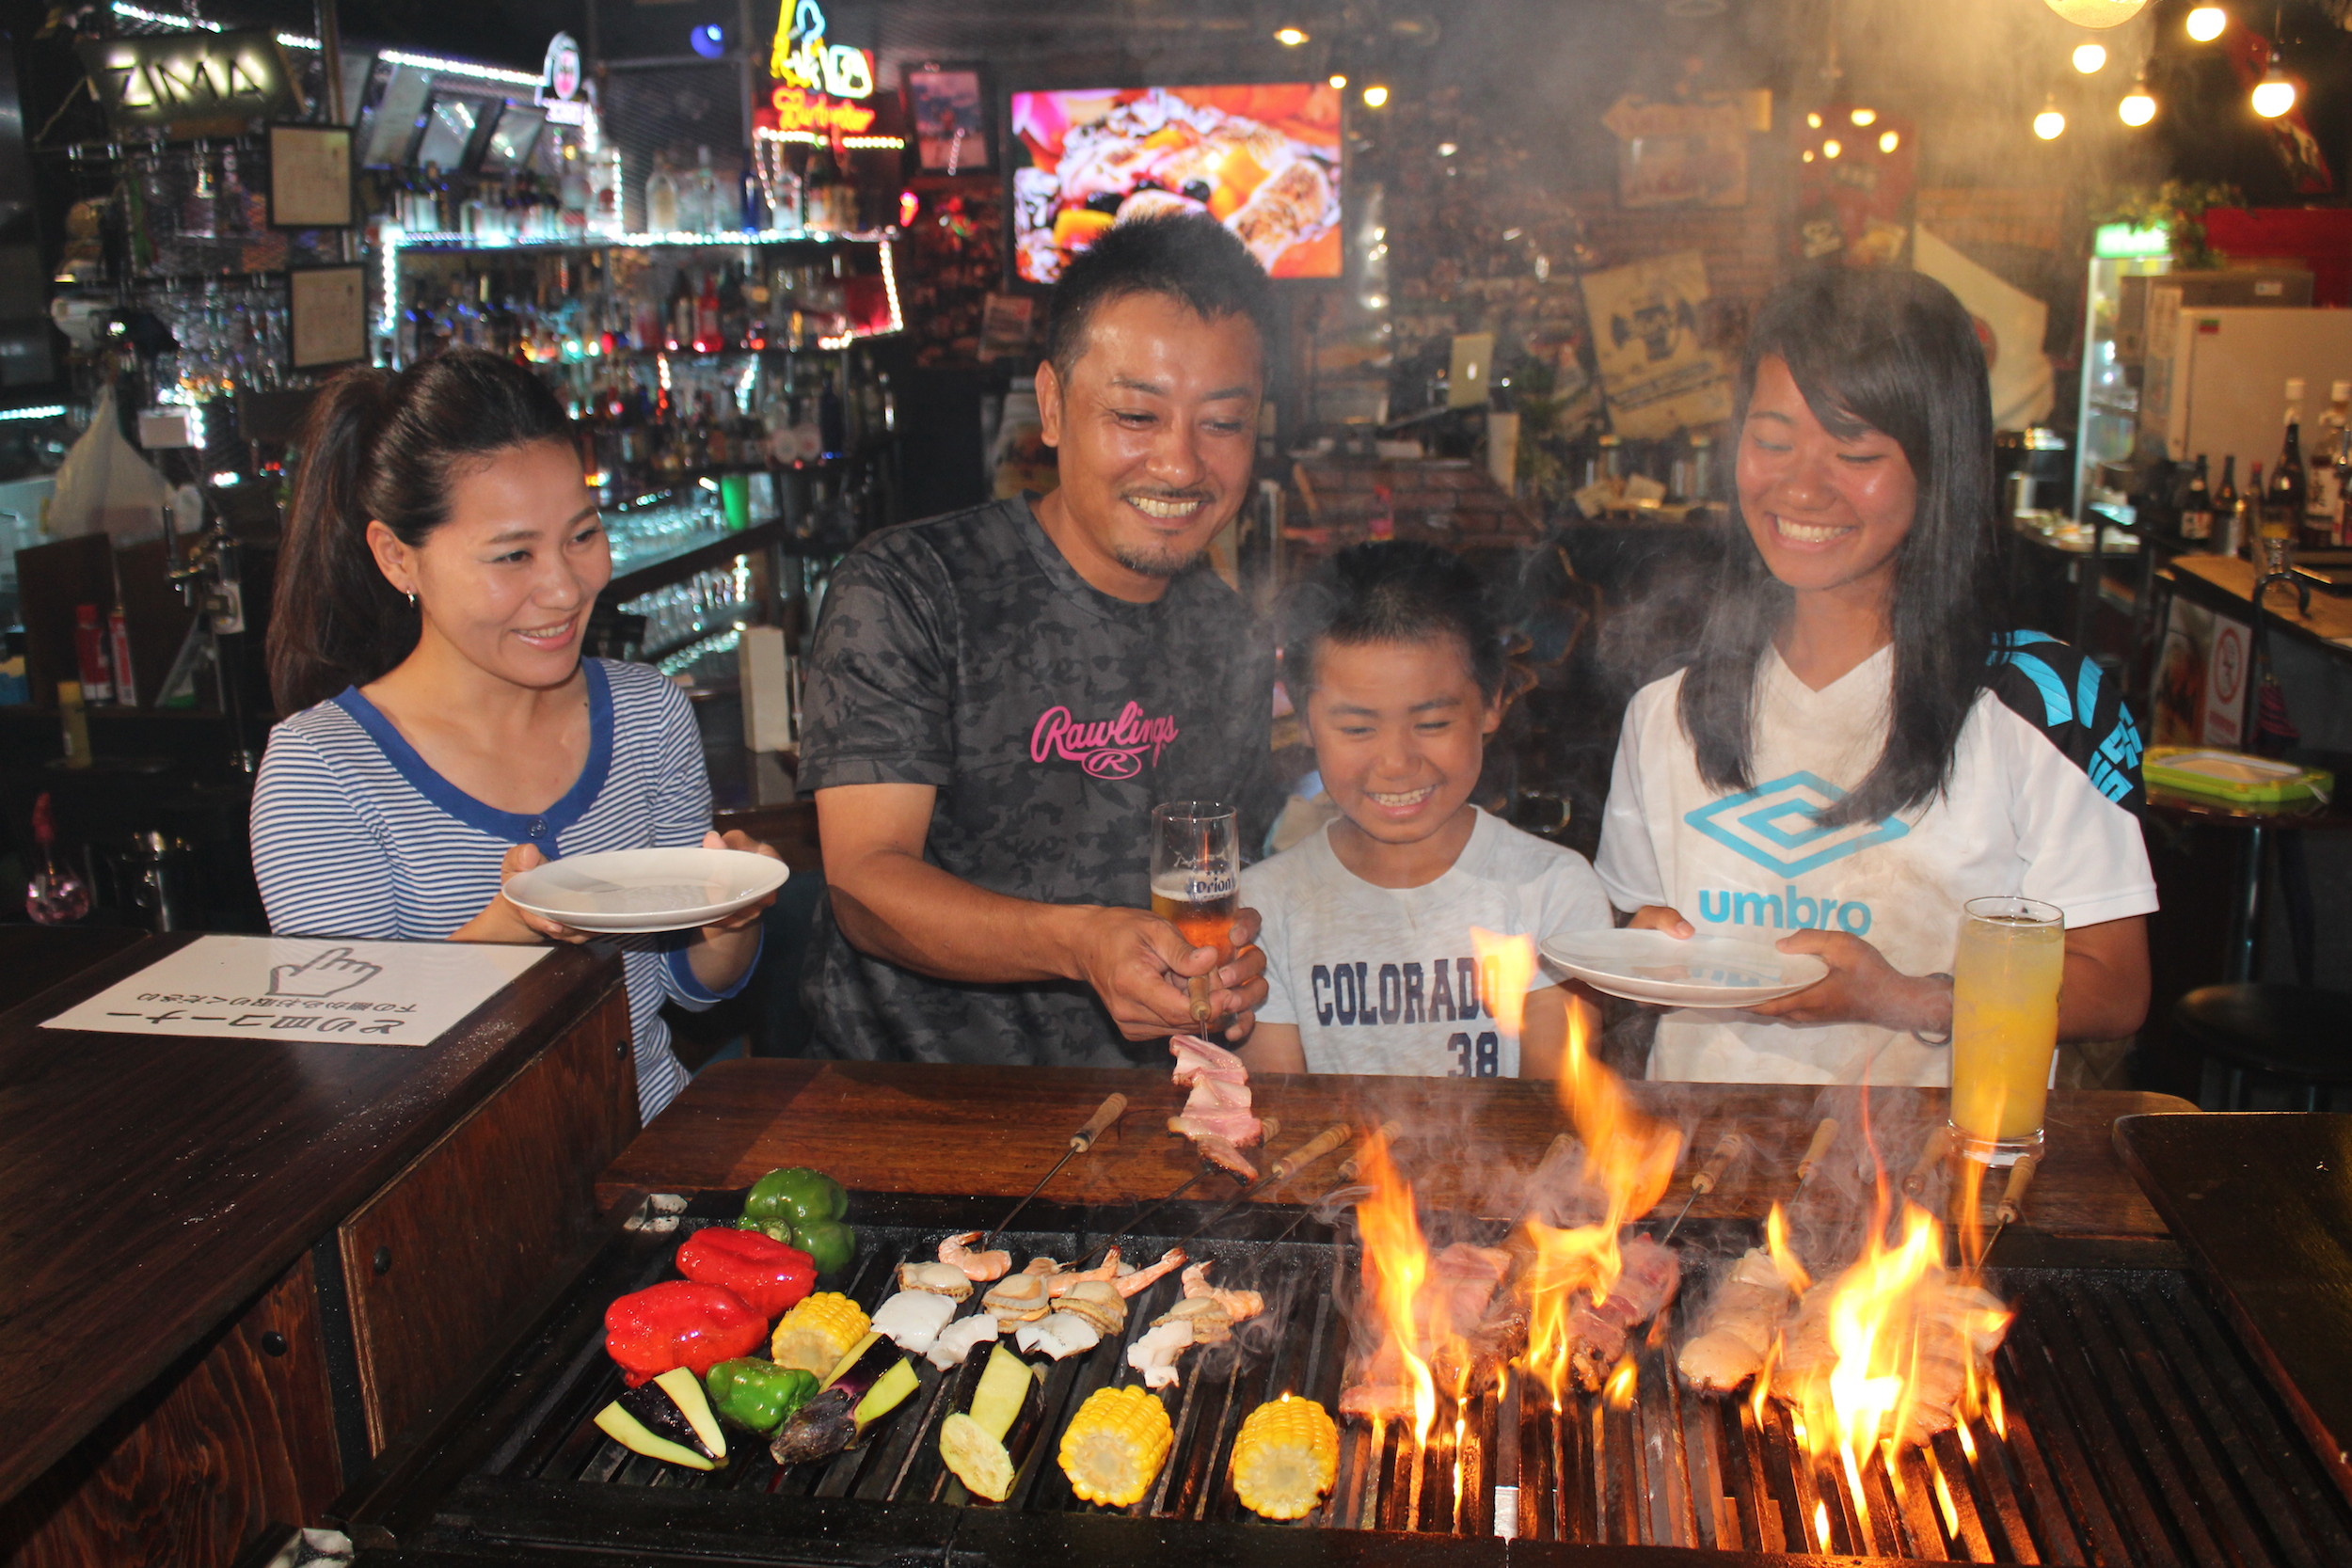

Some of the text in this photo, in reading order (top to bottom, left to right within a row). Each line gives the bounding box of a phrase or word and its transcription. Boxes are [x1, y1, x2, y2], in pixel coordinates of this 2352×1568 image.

[104, 57, 265, 110] ZIMA
[1030, 700, 1179, 768] Rawlings
[1194, 876, 1232, 895] Orion
[1698, 885, 1872, 938] umbro
[1311, 955, 1501, 1027] COLORADO
[104, 1009, 405, 1035] とり皿コーナー
[1447, 1031, 1499, 1078] 38
